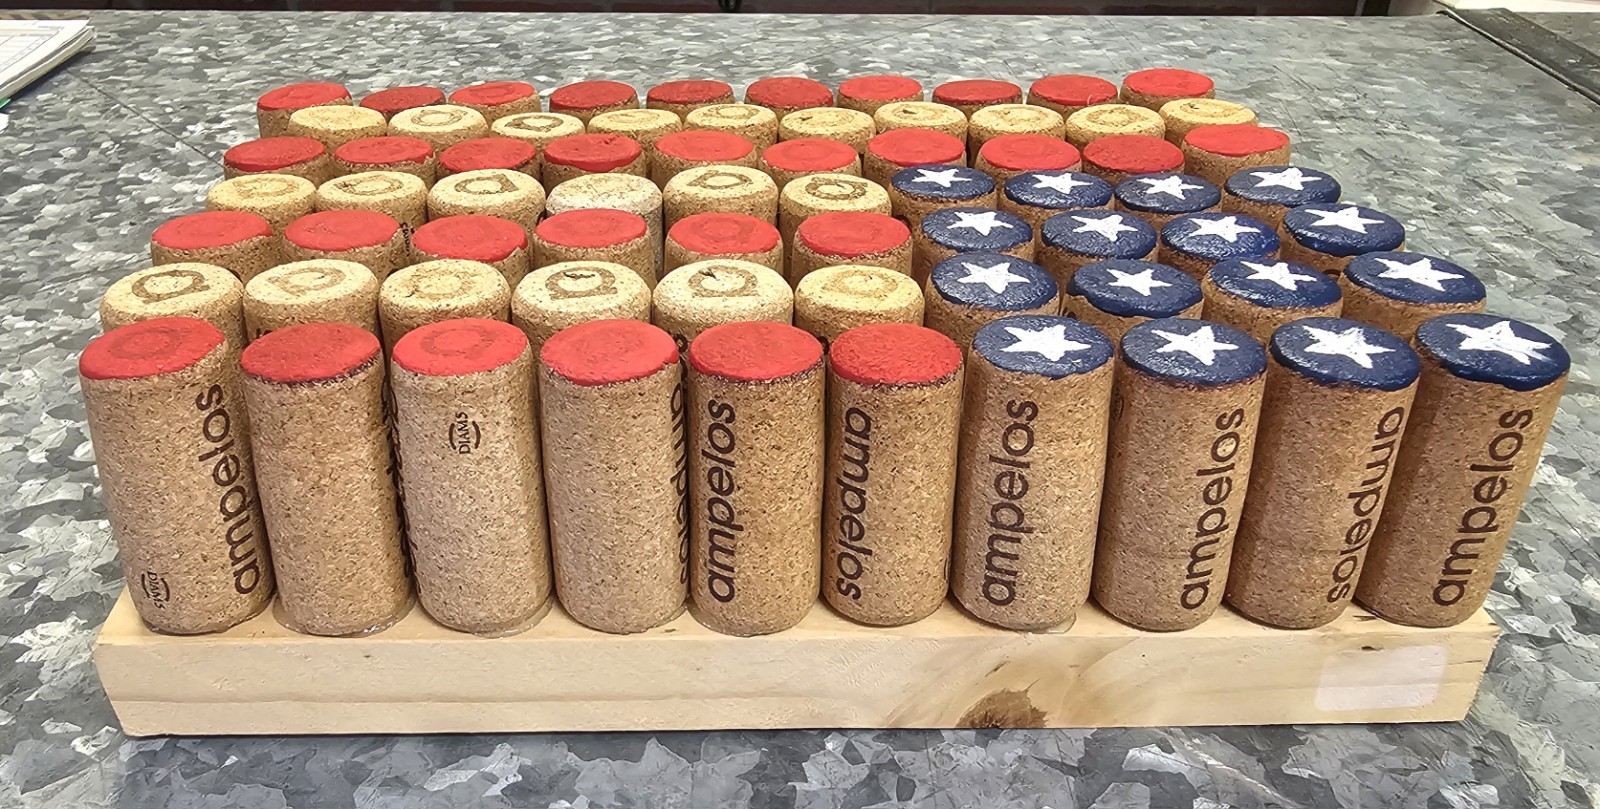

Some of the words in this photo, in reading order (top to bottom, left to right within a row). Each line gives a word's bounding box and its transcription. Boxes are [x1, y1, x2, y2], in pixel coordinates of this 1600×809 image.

[195, 384, 260, 594] ampelos
[701, 399, 744, 603] ampelos
[835, 406, 873, 600] ampelos
[981, 399, 1039, 607] ampelos
[1180, 407, 1245, 610] ampelos
[1327, 406, 1405, 603] ampelos
[1432, 409, 1534, 607] ampelos
[146, 570, 166, 610] DIAMS
